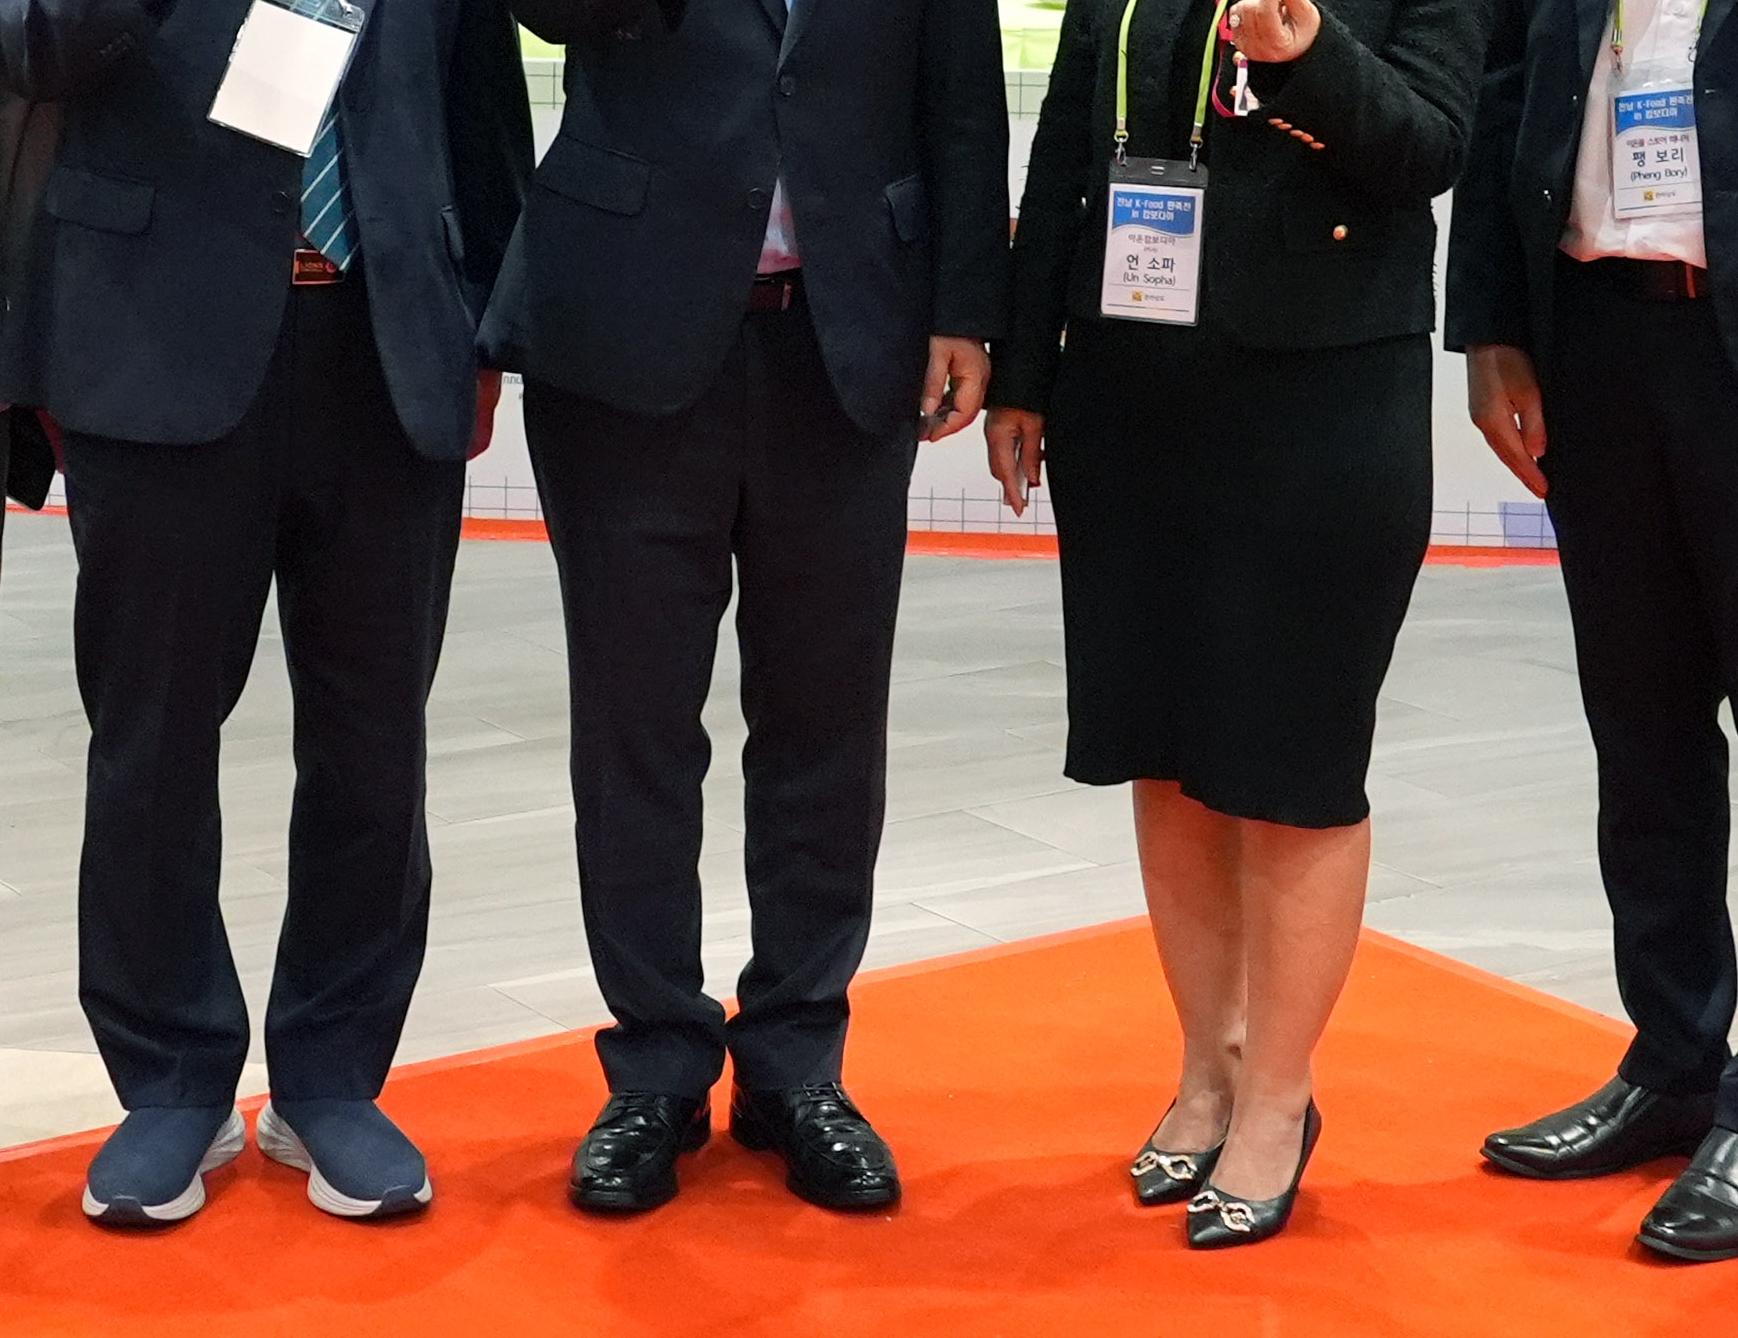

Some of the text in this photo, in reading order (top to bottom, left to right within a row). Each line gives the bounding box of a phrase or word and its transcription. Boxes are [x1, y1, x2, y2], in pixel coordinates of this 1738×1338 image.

[1656, 147, 1684, 163] 보리
[1147, 256, 1176, 273] 소파
[1123, 272, 1176, 286] (Un Sopha)
